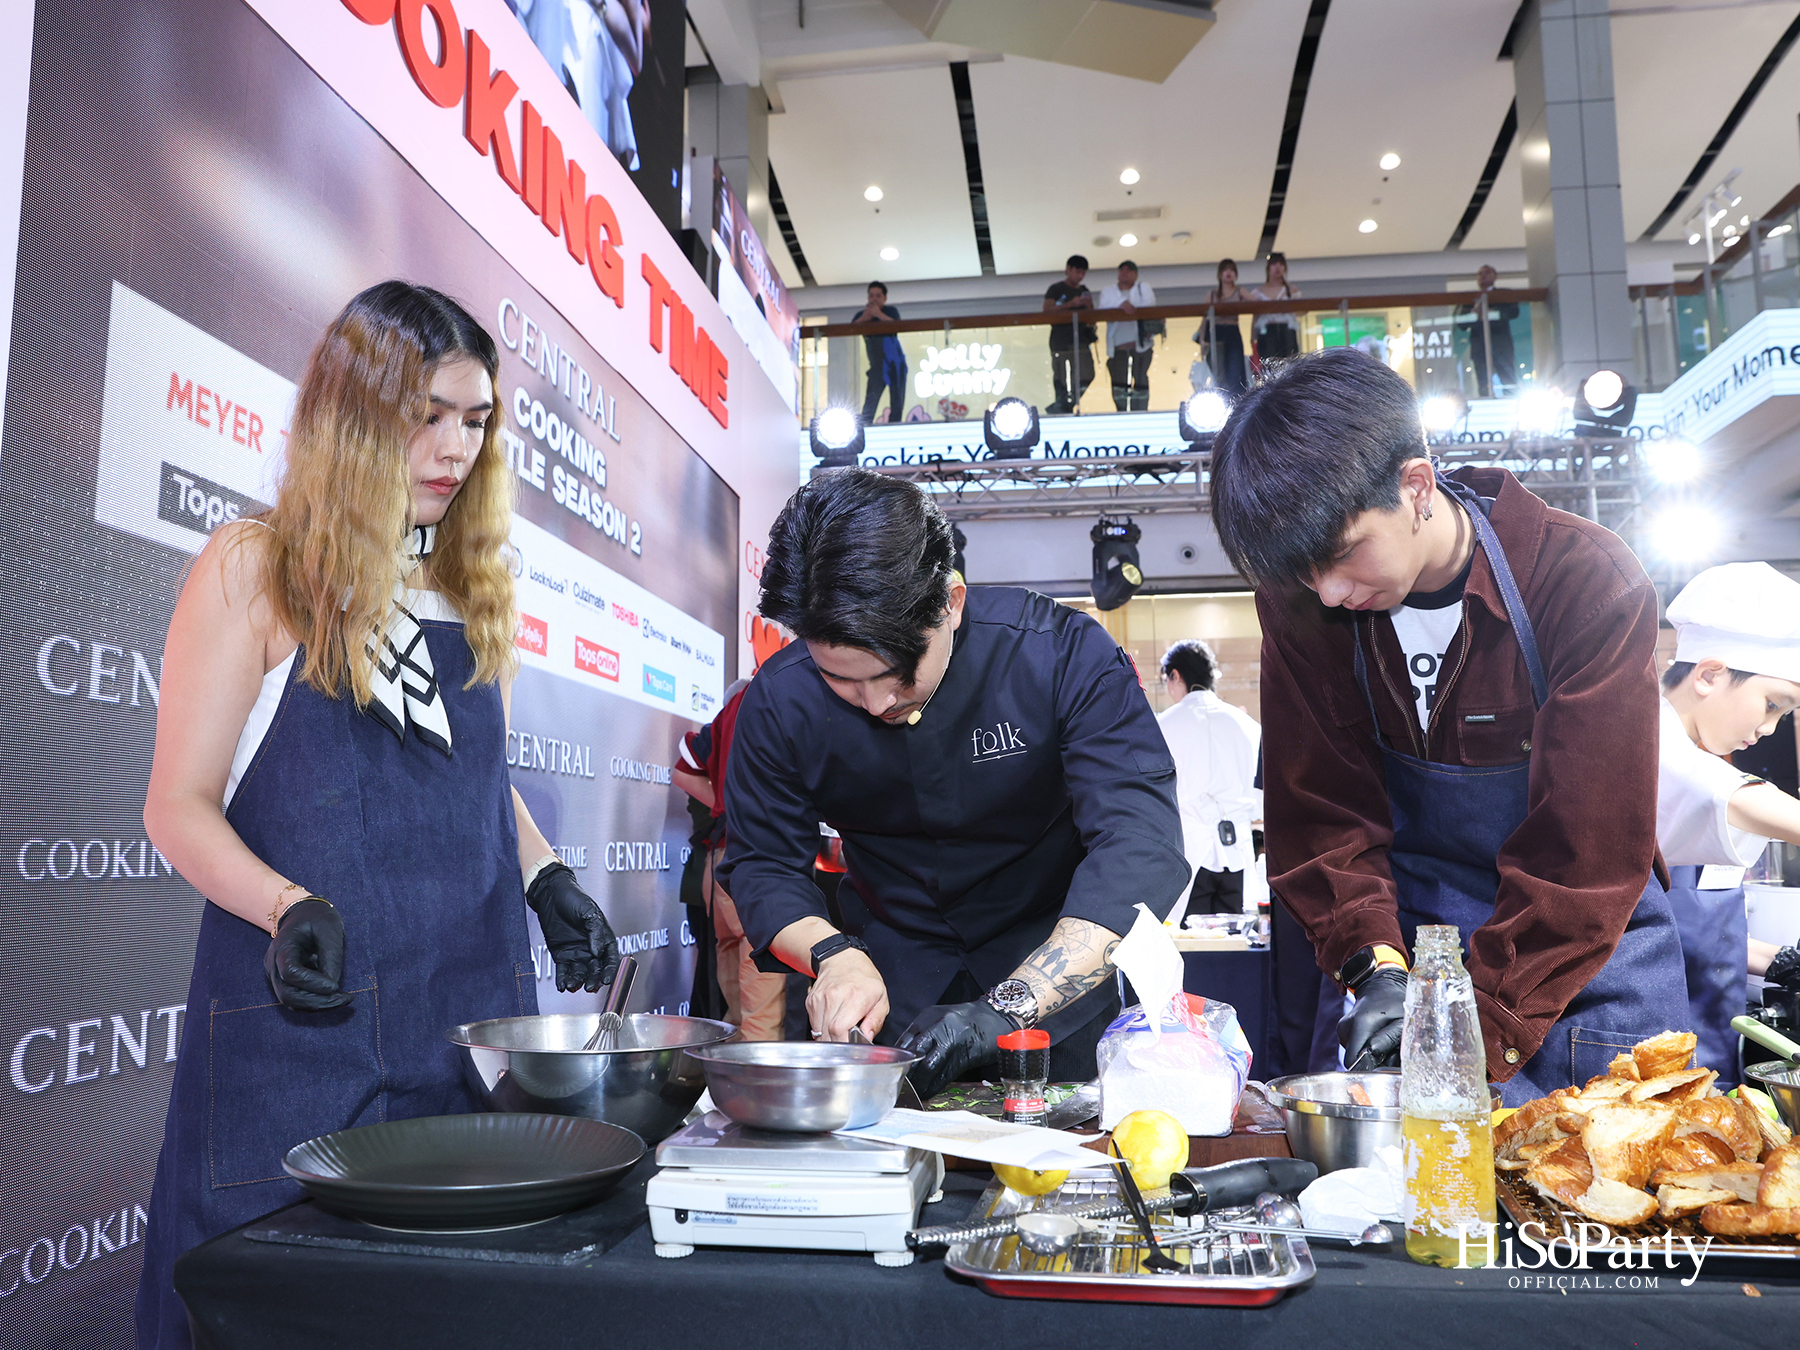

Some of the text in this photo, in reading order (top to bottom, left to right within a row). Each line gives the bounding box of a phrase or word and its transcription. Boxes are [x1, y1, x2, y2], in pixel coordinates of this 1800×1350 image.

[340, 0, 729, 430] OKING TIME
[741, 229, 782, 313] CENTRAL
[497, 297, 621, 442] CENTRAL
[167, 372, 264, 454] MEYER
[1691, 377, 1729, 415] Your
[513, 387, 607, 488] COOKING
[172, 473, 240, 530] Tops
[552, 465, 627, 545] SEASON
[630, 521, 642, 555] 2
[612, 602, 640, 630] TOSHIBA
[577, 640, 617, 673] Tops online
[506, 729, 595, 778] CENTRAL
[971, 721, 1026, 757] folk
[610, 756, 672, 785] COOKING TIME
[18, 838, 174, 880] COOKIN
[561, 846, 587, 868] TIME
[605, 841, 670, 872] CENTRAL
[649, 928, 669, 949] TIME
[10, 1004, 187, 1094] CENT
[0, 1204, 149, 1298] COOKIN
